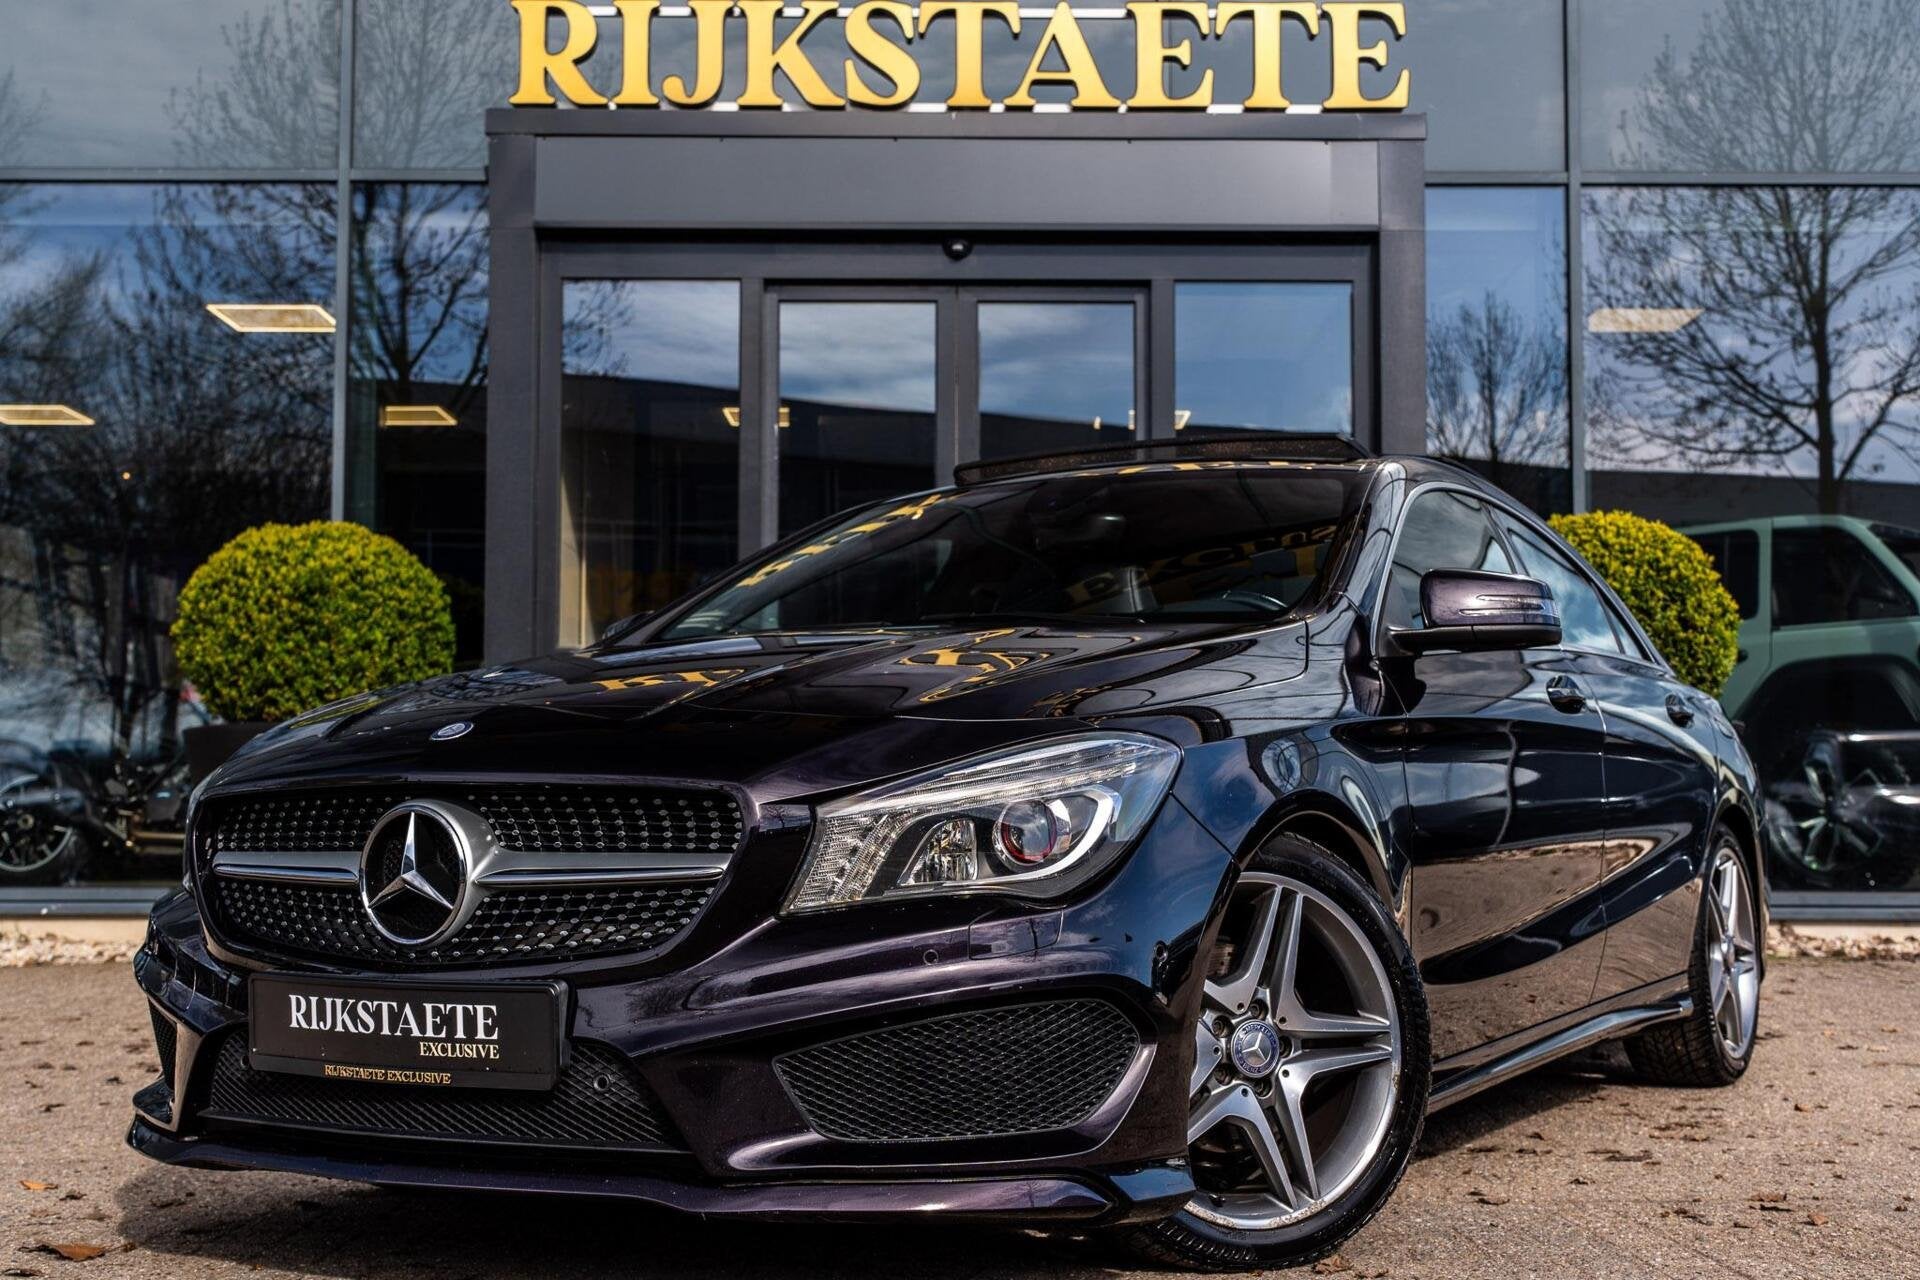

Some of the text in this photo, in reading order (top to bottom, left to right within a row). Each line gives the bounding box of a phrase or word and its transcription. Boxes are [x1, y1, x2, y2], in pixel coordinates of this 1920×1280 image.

[510, 0, 1411, 111] RIJKSTAETE
[288, 994, 499, 1040] RIJKSTAETE
[419, 1041, 500, 1060] EXCLUSIVE
[324, 1065, 451, 1084] RIJKSTAETE EXCLUSIVE
